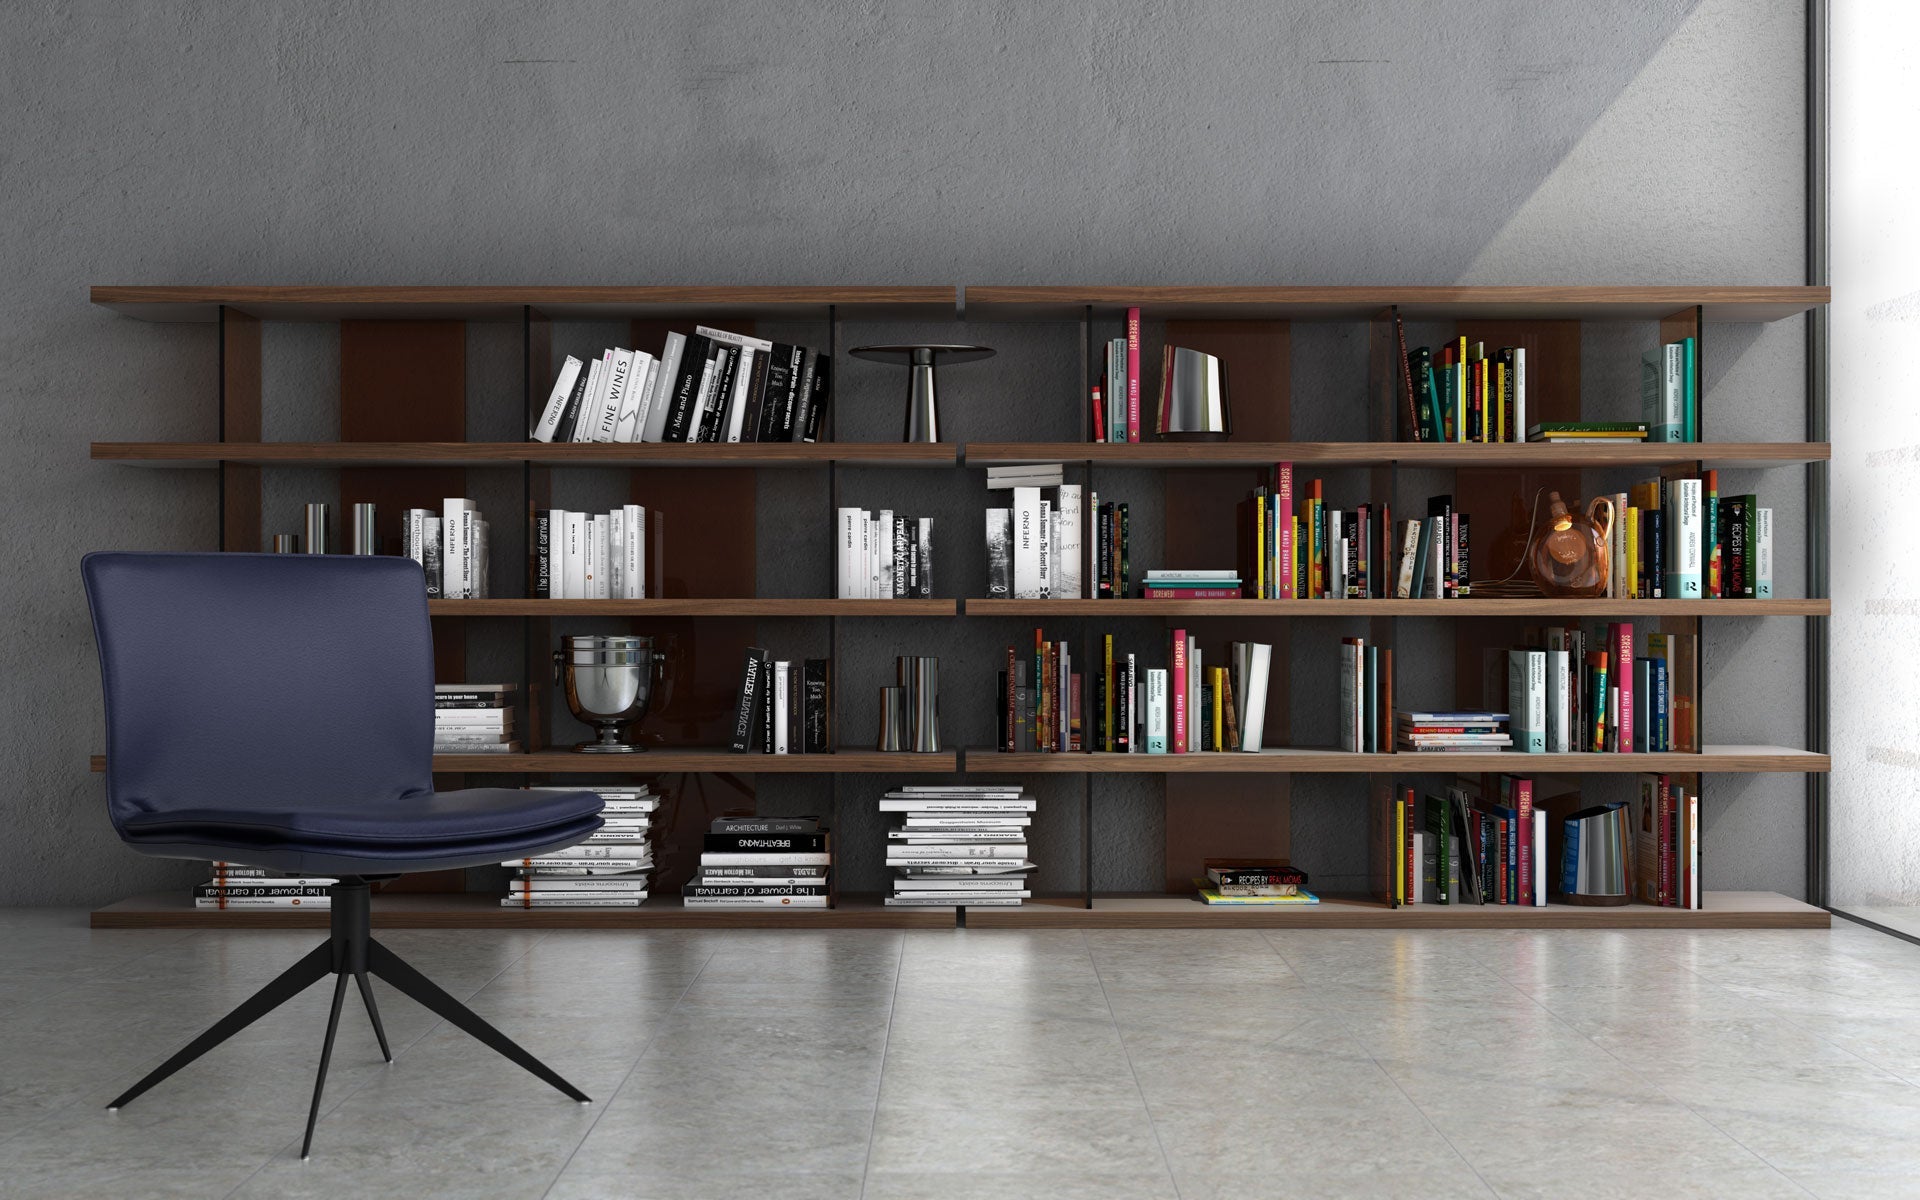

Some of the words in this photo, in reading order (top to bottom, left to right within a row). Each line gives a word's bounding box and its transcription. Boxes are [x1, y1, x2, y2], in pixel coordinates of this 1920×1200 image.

[793, 350, 801, 365] Inside
[682, 374, 693, 396] Piano
[602, 404, 617, 433] FINE
[610, 360, 627, 400] WINES
[679, 391, 688, 409] and
[786, 391, 795, 412] discover
[547, 395, 565, 426] INFERNO
[673, 411, 683, 428] Man
[783, 411, 792, 429] secrets
[1040, 502, 1048, 518] Donna
[537, 517, 548, 545] carnival
[1022, 510, 1030, 550] INFERNO
[1040, 519, 1048, 540] Summer
[1458, 524, 1467, 542] YOUNG
[1732, 523, 1741, 546] RECIPES
[537, 546, 548, 554] of
[1040, 543, 1048, 551] The
[1458, 548, 1467, 558] THE
[540, 556, 550, 577] power
[1040, 552, 1048, 568] Secret
[1732, 555, 1741, 570] REAL
[1040, 568, 1048, 580] Story
[1458, 560, 1467, 578] SHACK
[537, 578, 548, 591] The
[1732, 572, 1741, 592] MOMS
[1239, 876, 1260, 884] RECIPES
[1261, 876, 1267, 884] BY
[254, 888, 264, 897] of
[269, 885, 302, 894] power
[694, 888, 738, 896] carnival
[758, 884, 792, 894] power
